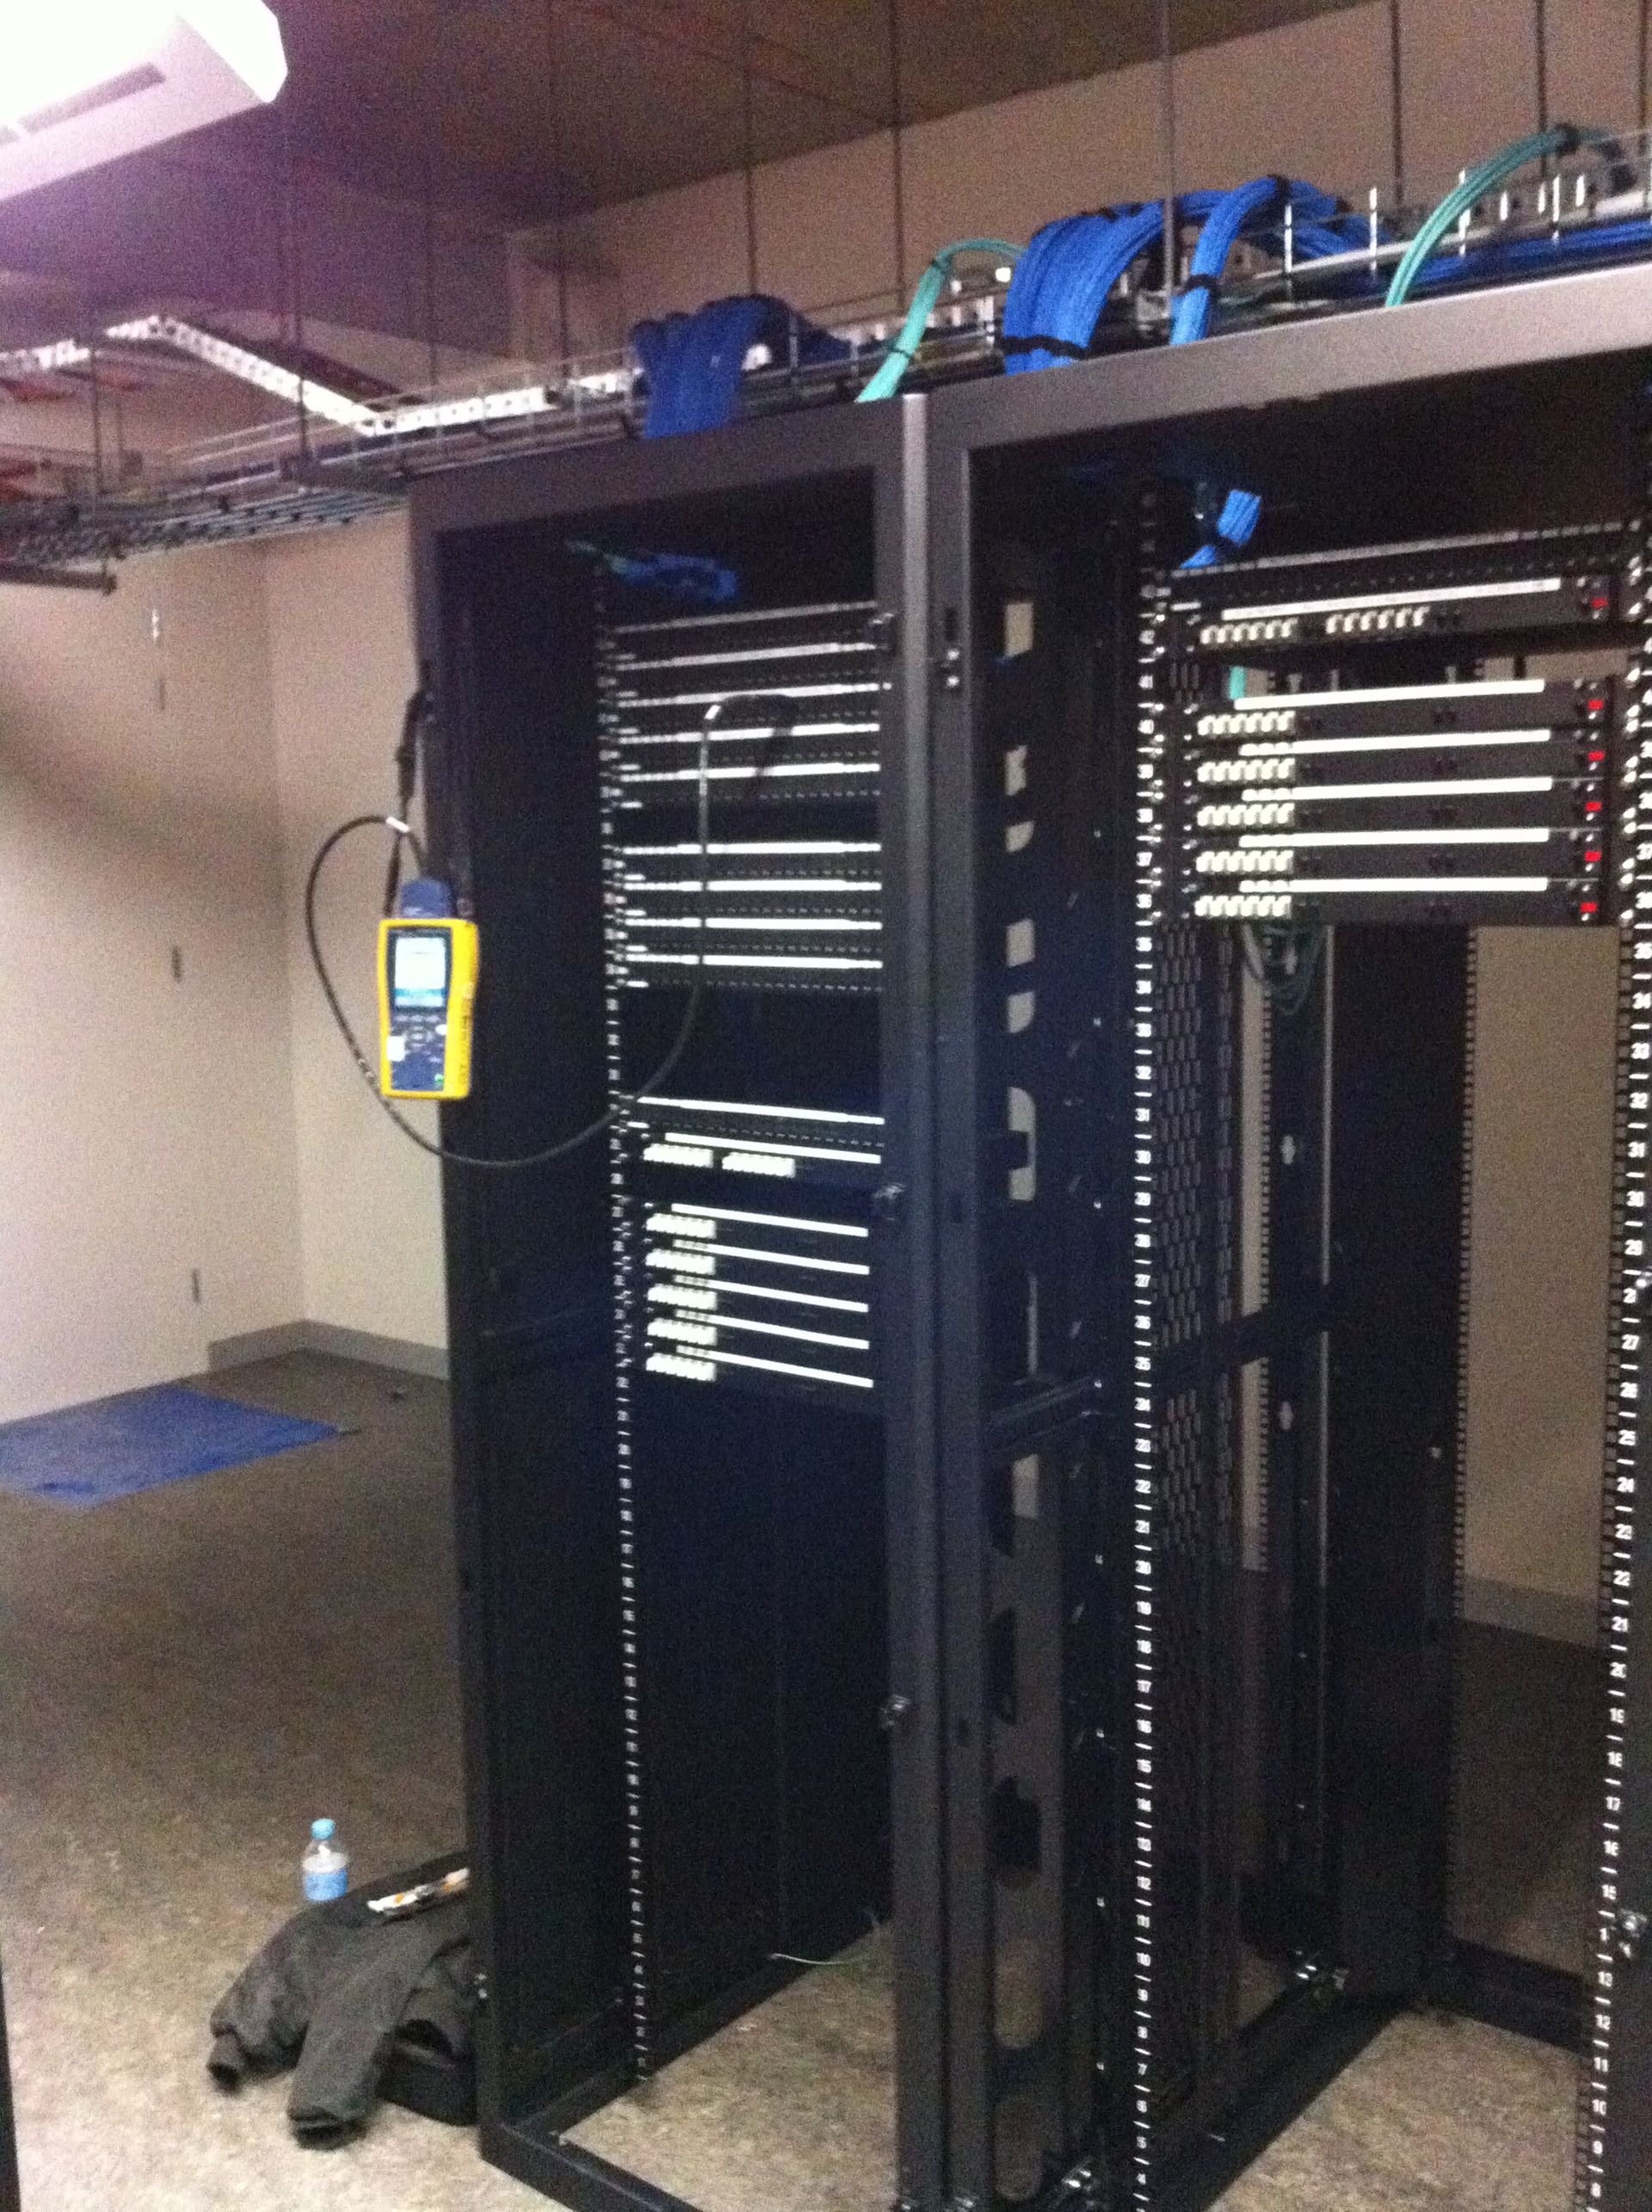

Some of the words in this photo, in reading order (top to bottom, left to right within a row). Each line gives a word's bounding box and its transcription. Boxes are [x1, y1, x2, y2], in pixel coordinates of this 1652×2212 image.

[1630, 1093, 1649, 1109] 32
[1628, 1142, 1646, 1157] 31
[1622, 1334, 1640, 1350] 27
[1619, 1430, 1636, 1445] 25
[1618, 1477, 1634, 1493] 24
[1615, 1524, 1632, 1539] 23
[1614, 1570, 1630, 1587] 22
[1612, 1617, 1628, 1631] 21
[1596, 2015, 1610, 2030] 12
[1594, 2057, 1607, 2072] 11
